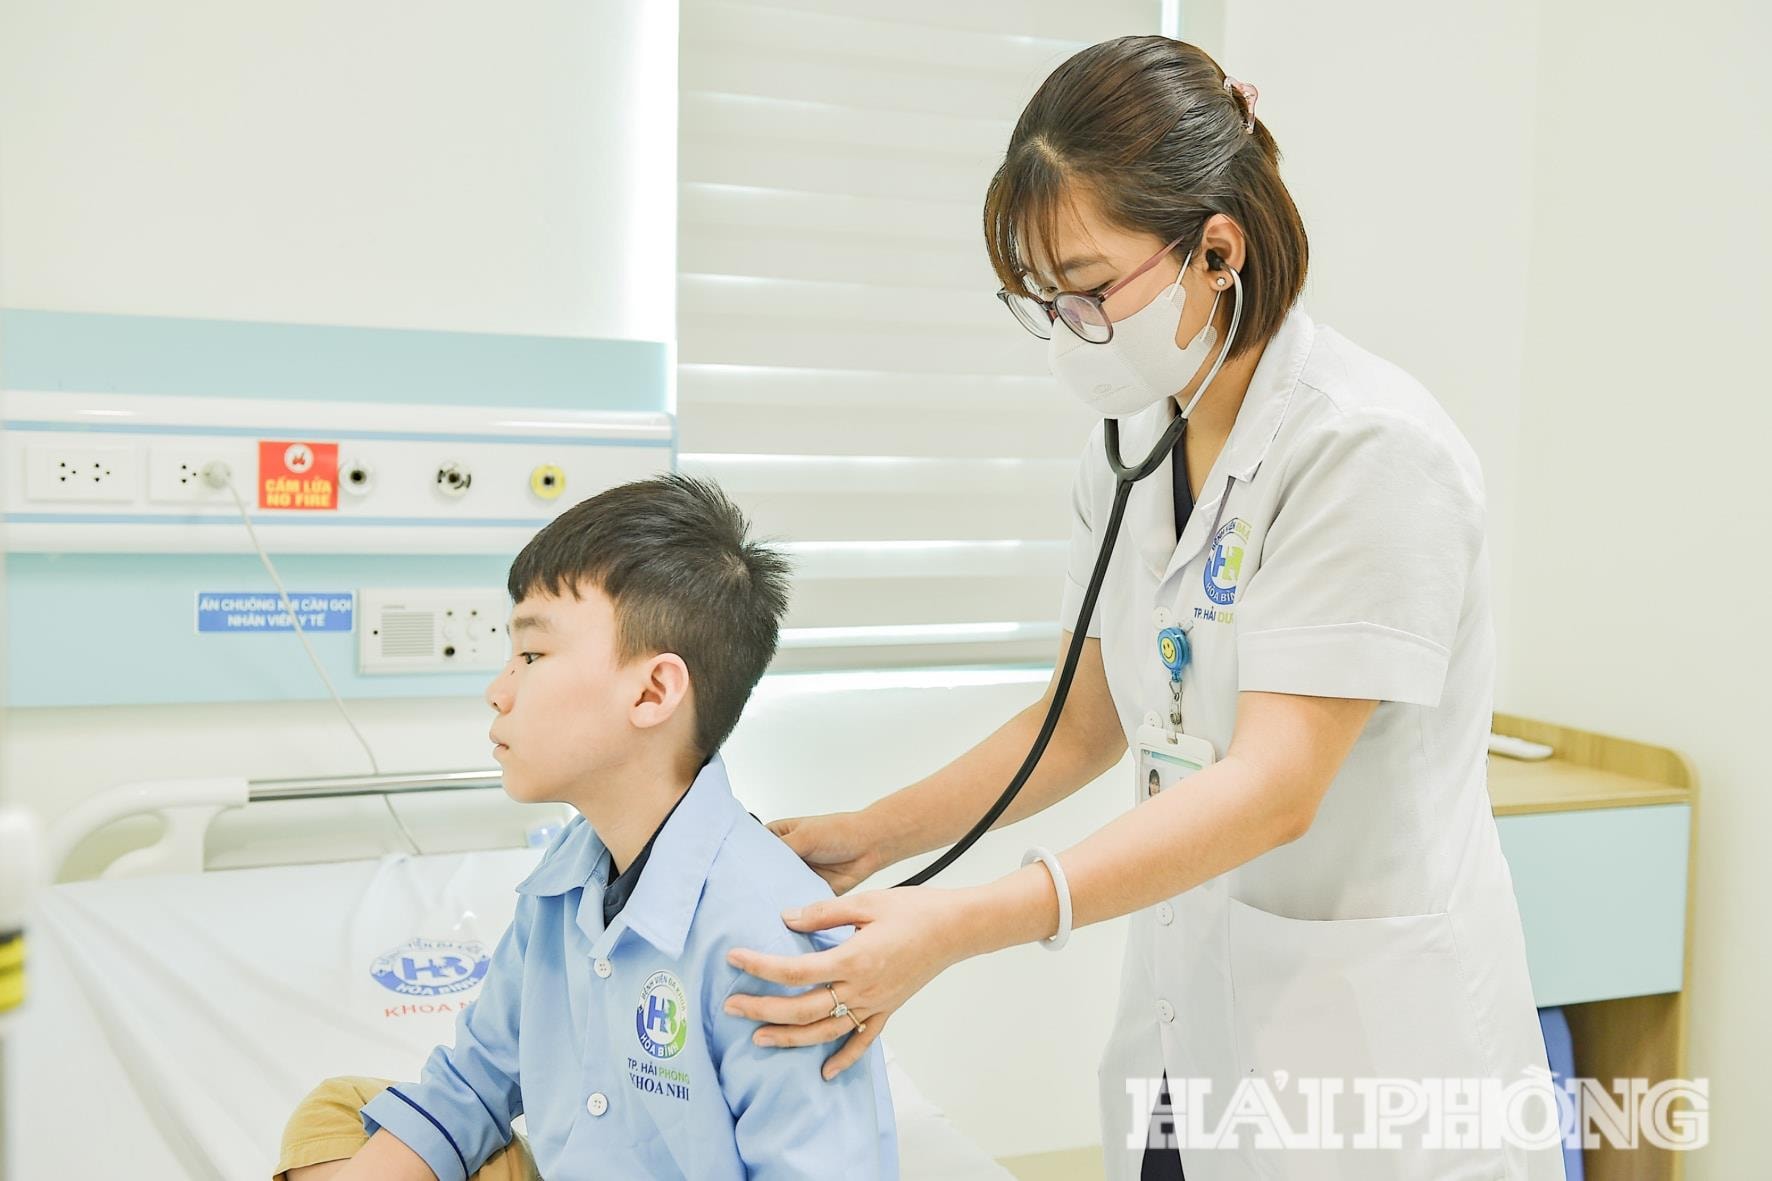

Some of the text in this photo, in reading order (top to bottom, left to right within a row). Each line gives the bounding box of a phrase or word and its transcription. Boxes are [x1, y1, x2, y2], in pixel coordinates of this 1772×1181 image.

[266, 493, 330, 507] NO FIRE
[384, 1003, 453, 1018] KHOA
[641, 1061, 657, 1076] HẢI
[666, 1083, 690, 1101] NHI
